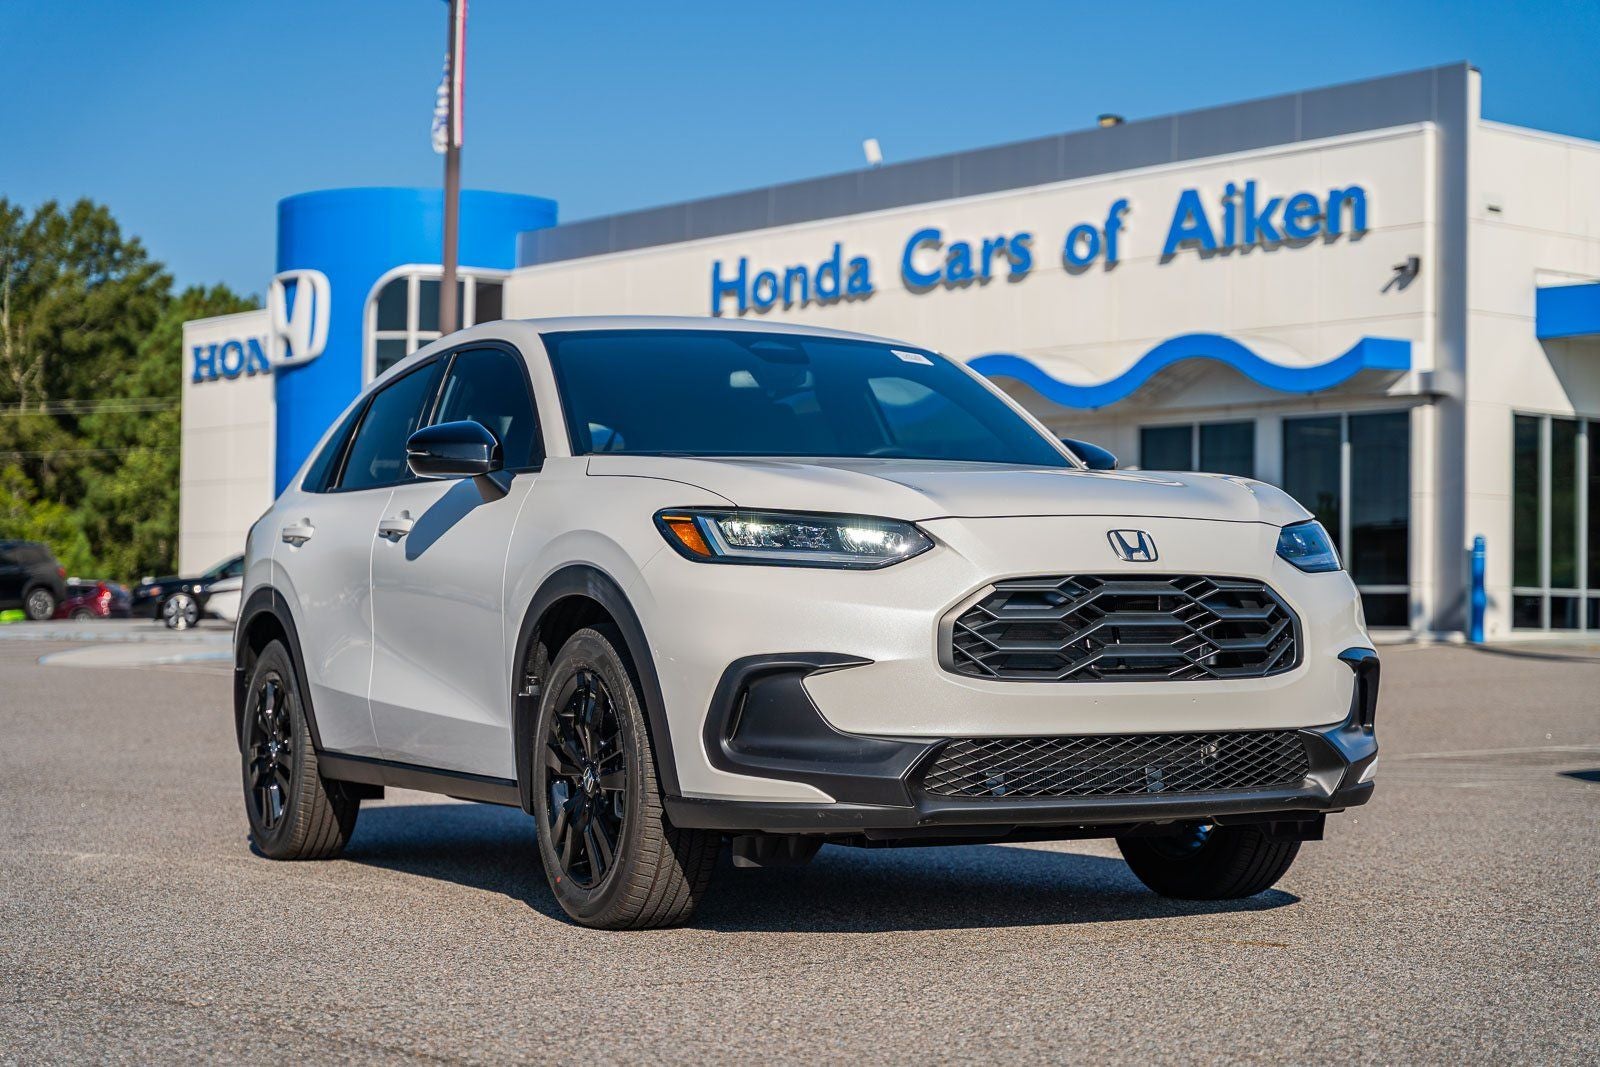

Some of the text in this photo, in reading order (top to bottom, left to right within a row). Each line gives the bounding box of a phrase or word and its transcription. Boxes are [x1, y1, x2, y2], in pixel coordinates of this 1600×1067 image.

[711, 180, 1367, 314] Honda Cars of Aiken
